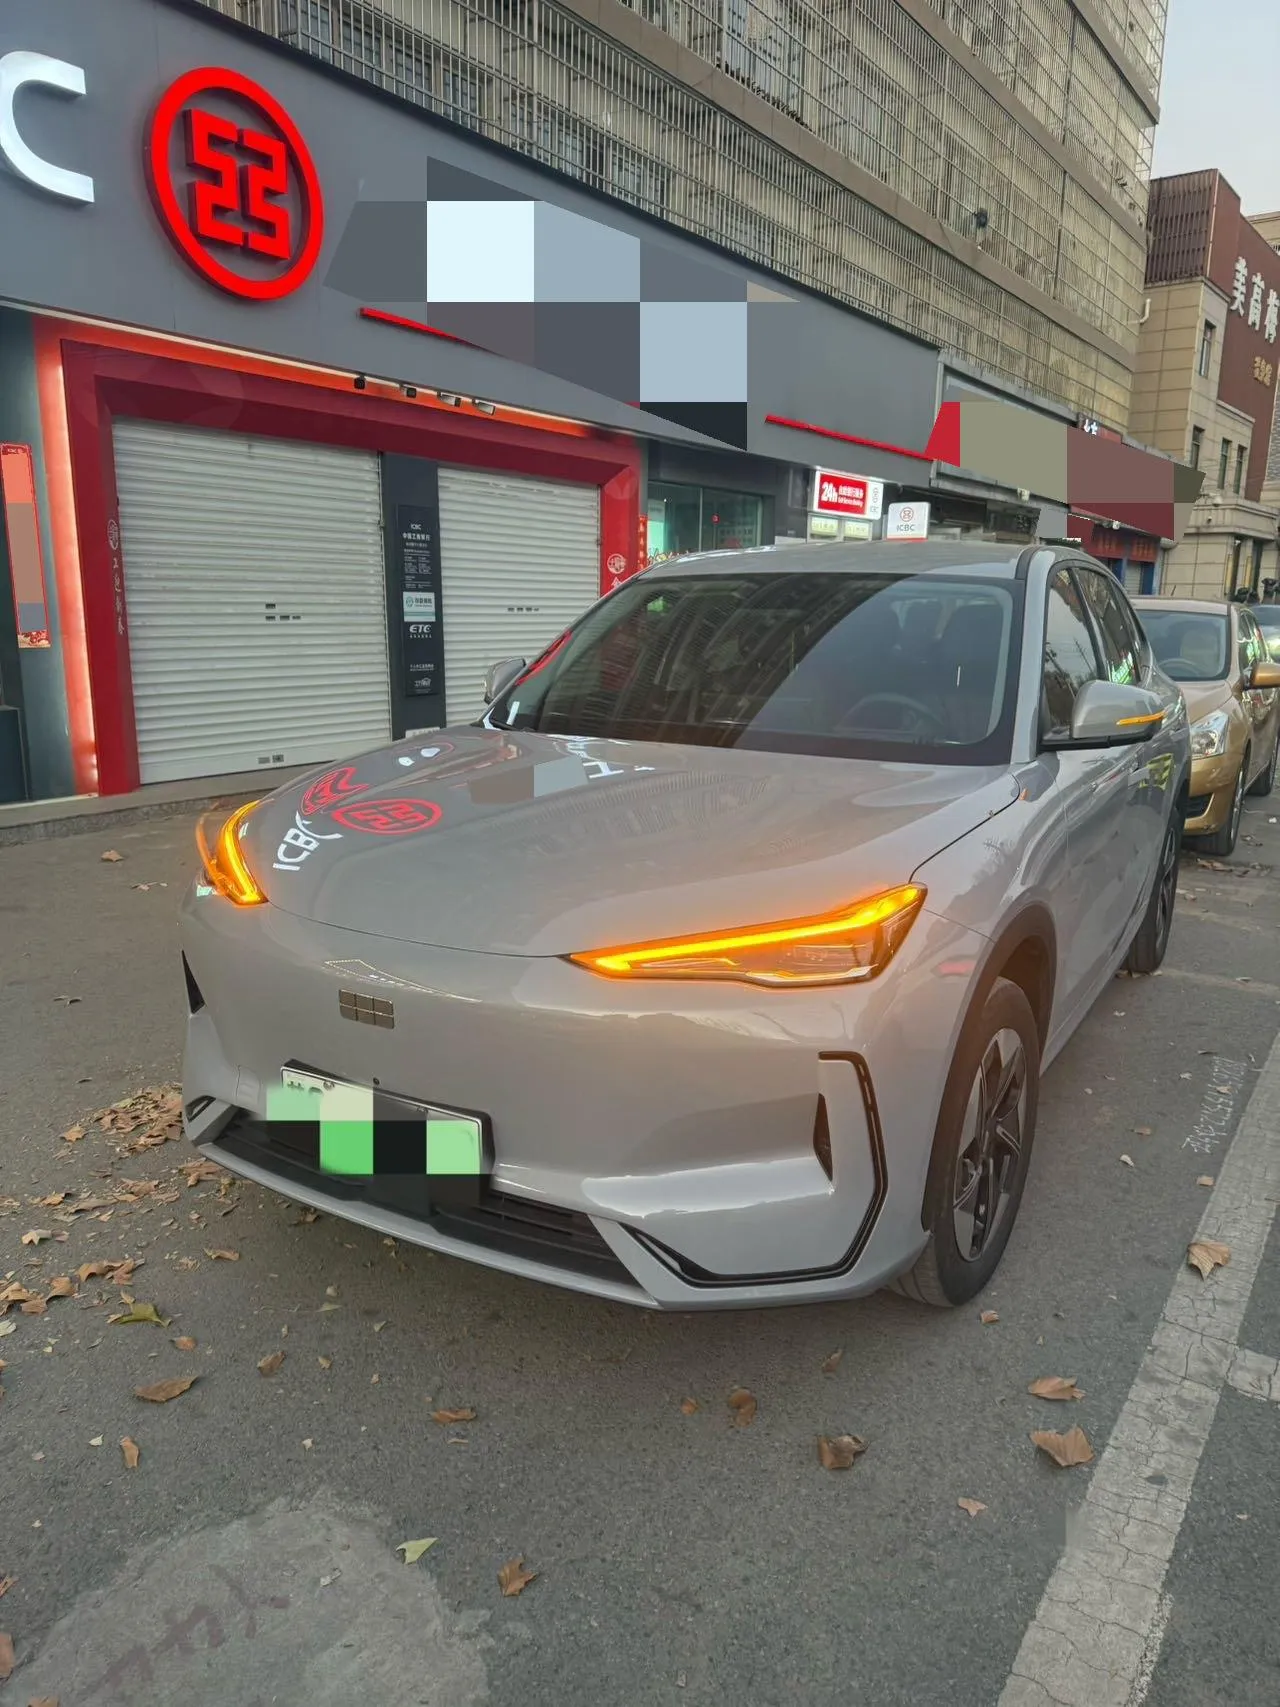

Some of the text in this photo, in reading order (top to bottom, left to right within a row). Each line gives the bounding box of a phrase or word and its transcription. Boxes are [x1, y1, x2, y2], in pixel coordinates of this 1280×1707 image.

[821, 481, 838, 502] 24h
[896, 523, 915, 532] ICBC
[409, 624, 432, 633] ETC
